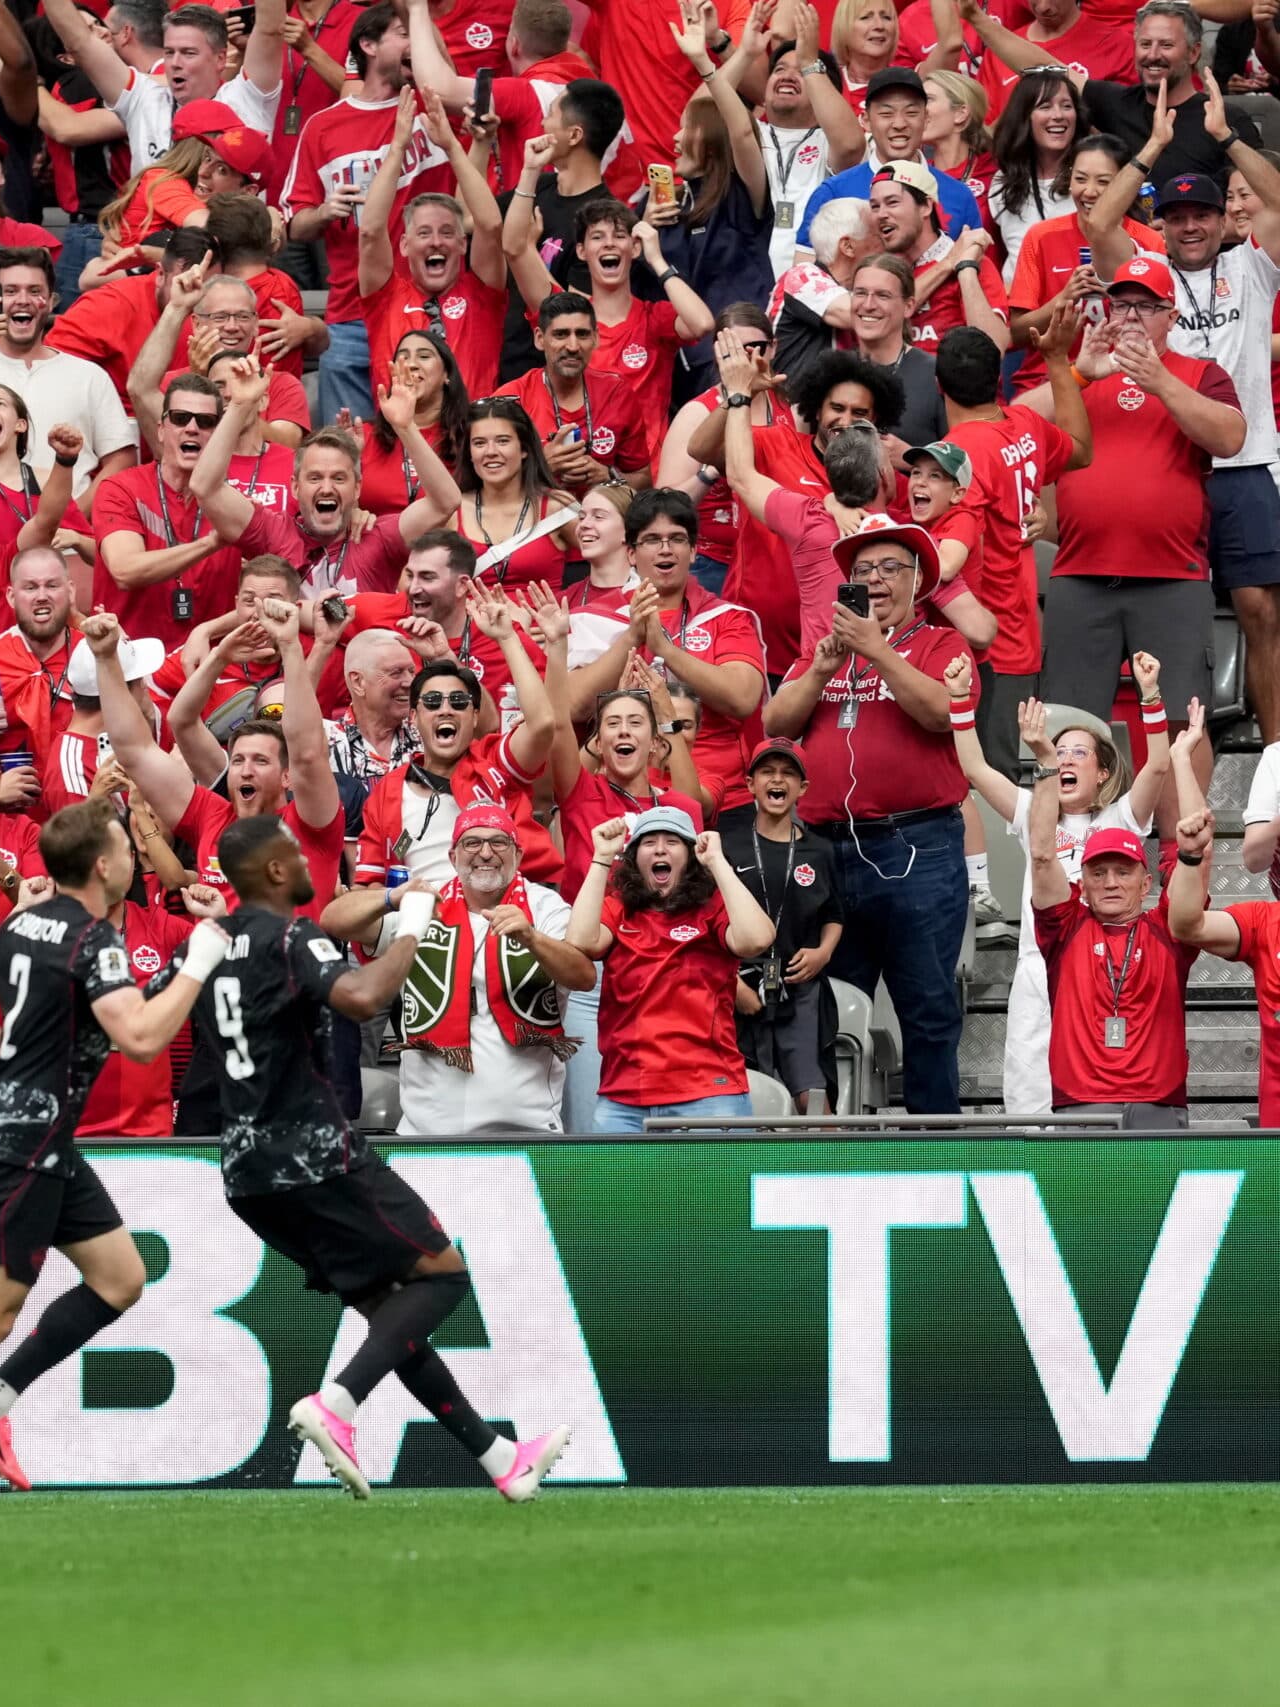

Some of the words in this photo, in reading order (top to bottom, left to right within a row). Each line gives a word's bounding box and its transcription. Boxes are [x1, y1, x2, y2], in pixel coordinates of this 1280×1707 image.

[1175, 308, 1241, 332] ANADA
[821, 687, 876, 703] hartered
[214, 976, 256, 1080] 9
[750, 1170, 1246, 1463] TV
